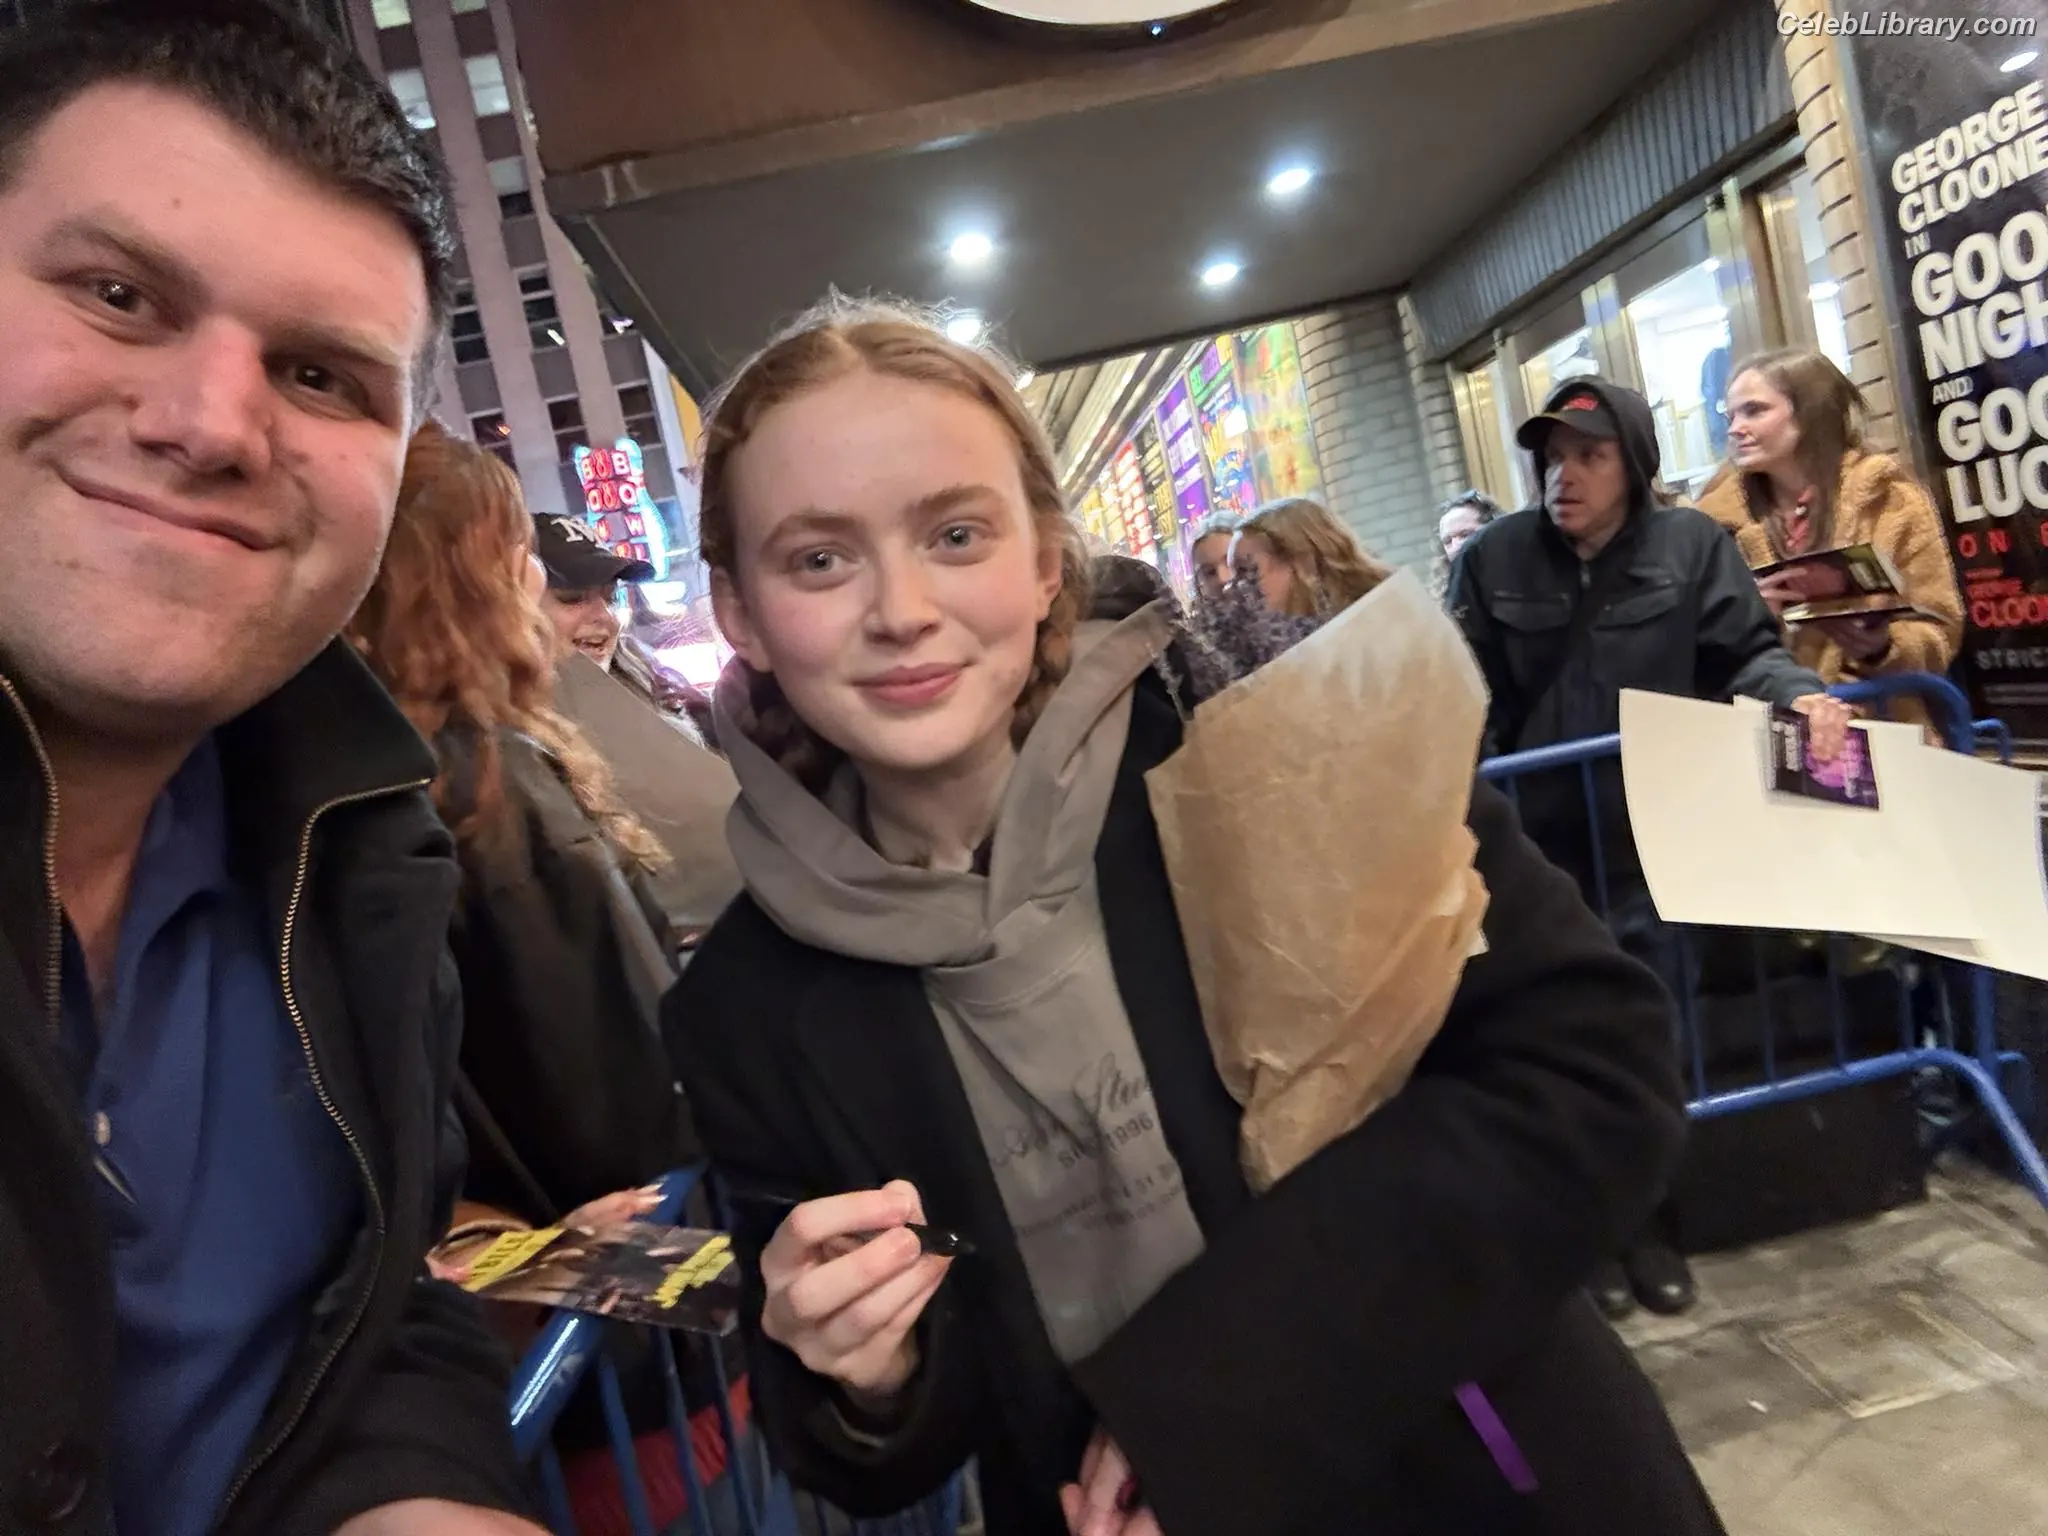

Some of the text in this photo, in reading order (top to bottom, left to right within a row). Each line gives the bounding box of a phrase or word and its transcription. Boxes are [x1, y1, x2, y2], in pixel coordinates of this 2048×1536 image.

[1891, 79, 2048, 194] GEORGE
[1904, 231, 1931, 260] IN
[1911, 205, 2048, 317] GOO
[1933, 375, 1974, 405] AND
[1957, 530, 2010, 558] ON
[1972, 594, 2048, 628] CLOO
